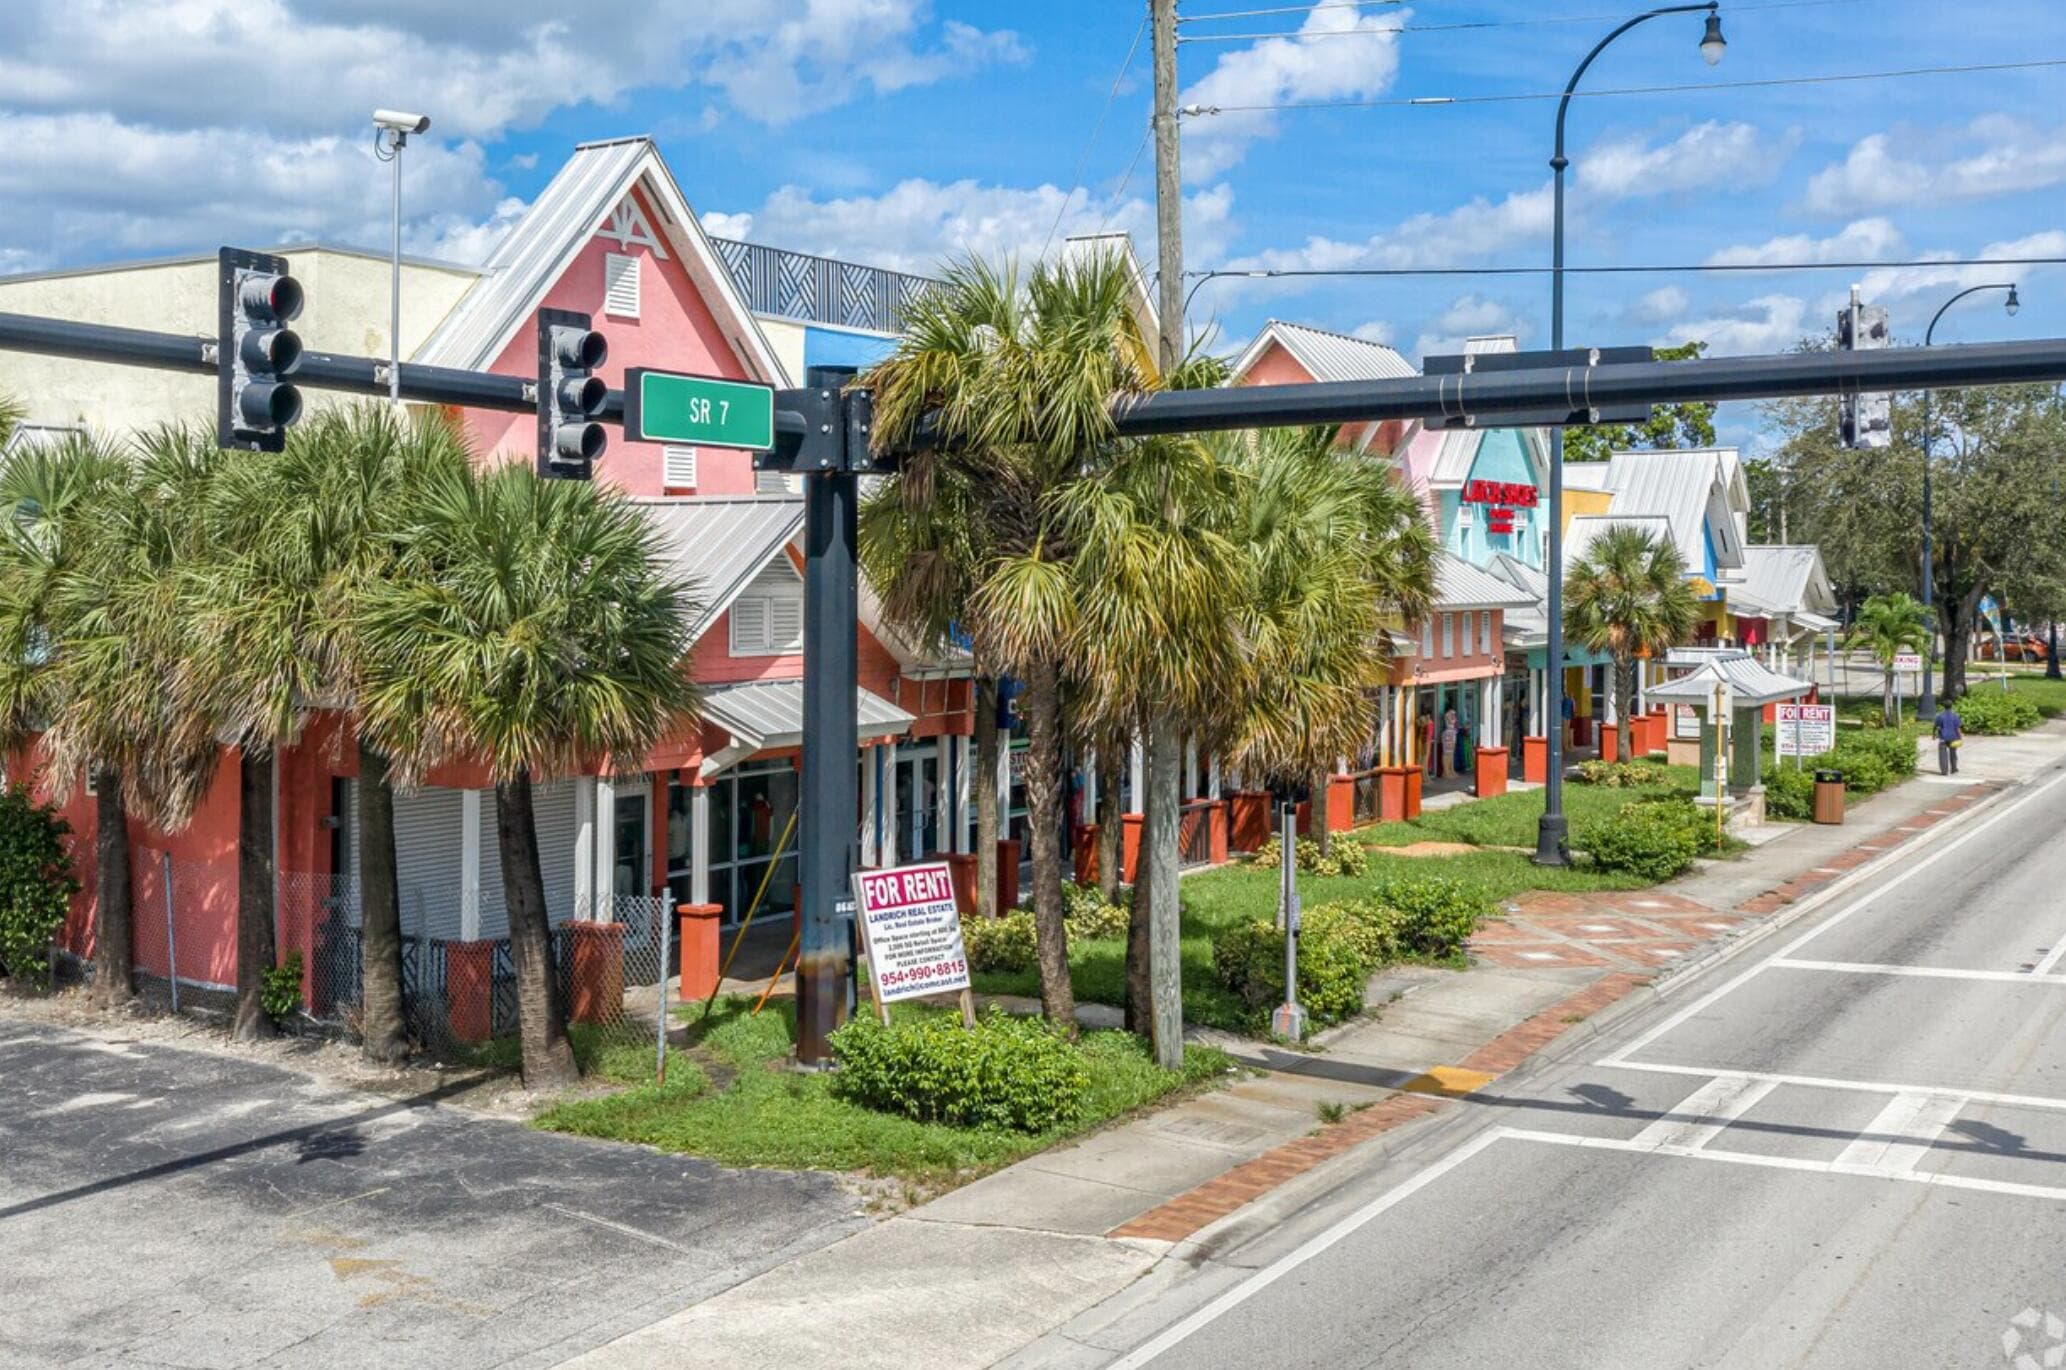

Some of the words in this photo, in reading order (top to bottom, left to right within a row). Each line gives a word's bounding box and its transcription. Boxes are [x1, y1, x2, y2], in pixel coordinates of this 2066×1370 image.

[690, 397, 711, 425] SR
[719, 400, 729, 425] 7
[1802, 708, 1829, 720] RENT
[865, 876, 902, 908] FOR
[903, 871, 948, 902] RENT
[869, 910, 906, 923] LANDRICH
[907, 906, 927, 917] REAL
[928, 903, 954, 914] ESTATE
[884, 952, 896, 960] FOR
[897, 950, 913, 958] MORE
[915, 944, 953, 955] INFORMATION
[896, 957, 917, 967] PLEASE
[919, 953, 945, 964] CONTACT
